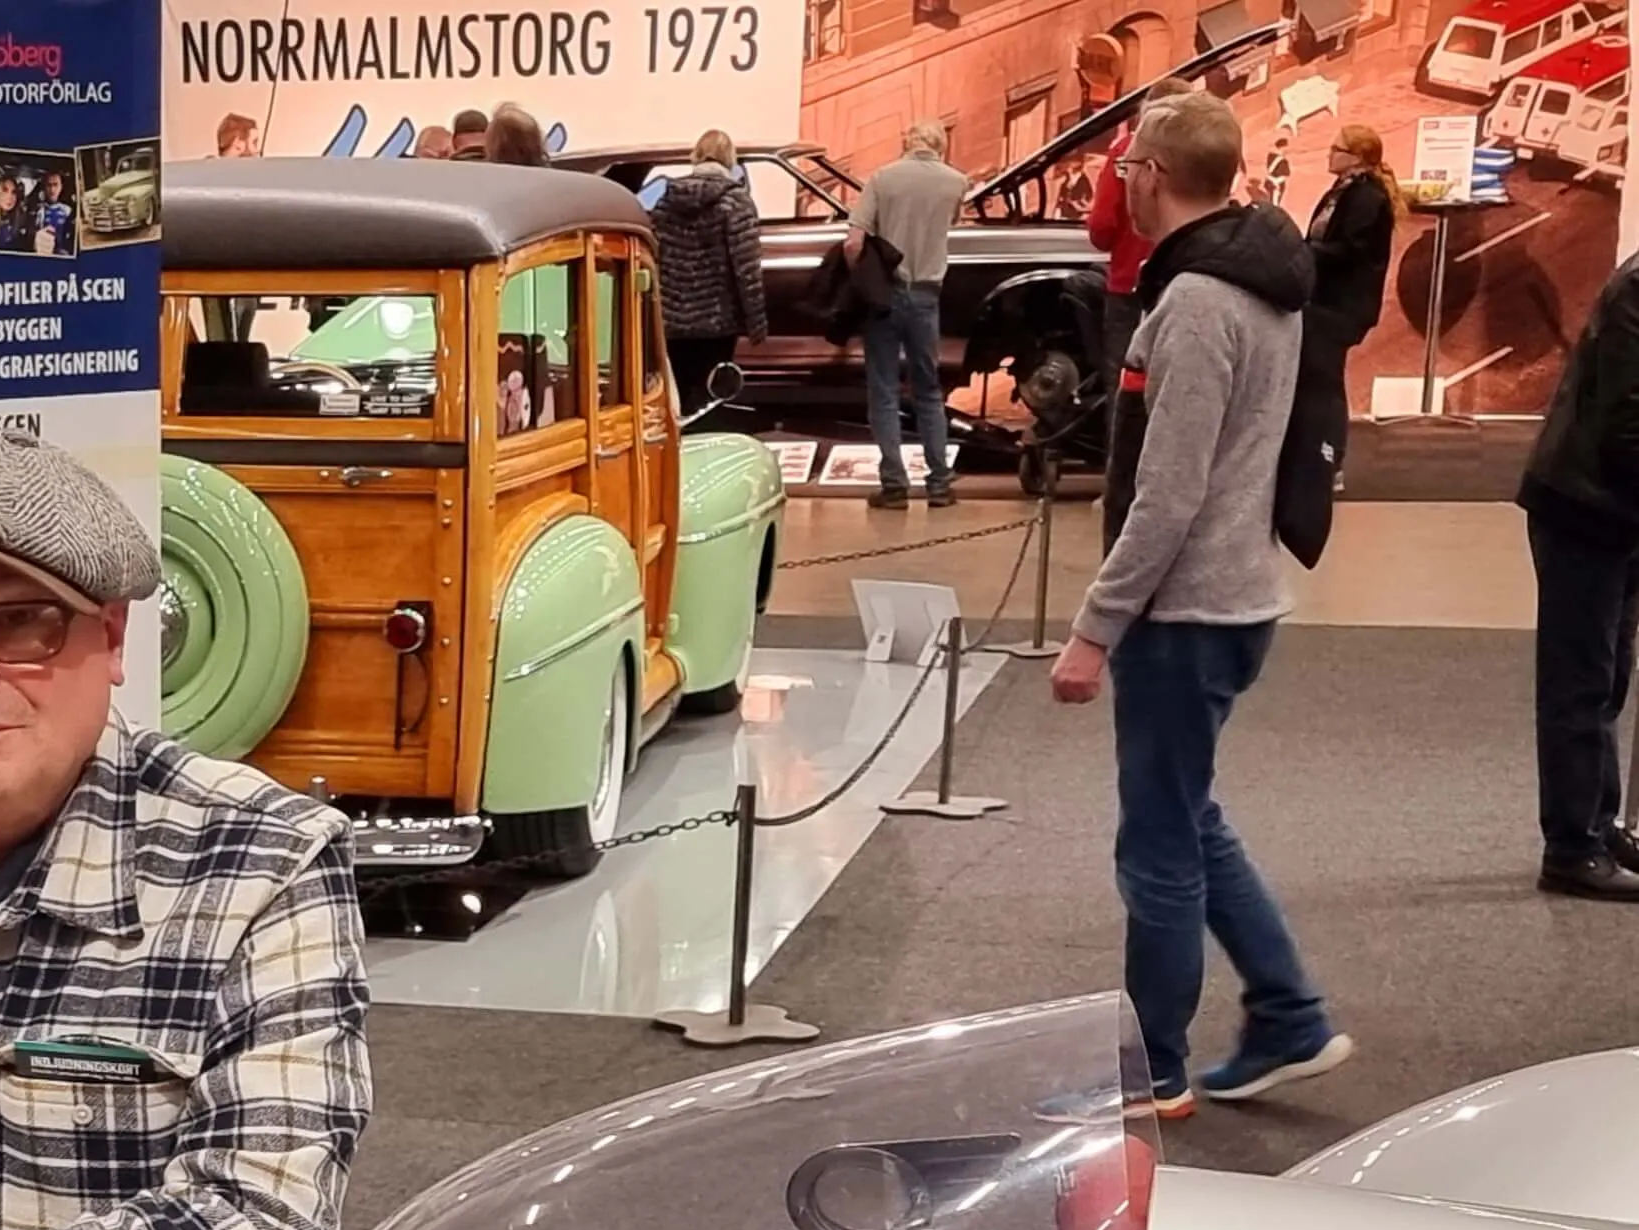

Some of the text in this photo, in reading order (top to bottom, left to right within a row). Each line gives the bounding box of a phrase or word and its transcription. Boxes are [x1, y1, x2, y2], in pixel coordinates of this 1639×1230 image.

[180, 5, 759, 83] NORRMALMSTORG 1973
[57, 273, 79, 303] PÅ
[82, 278, 125, 301] SCEN
